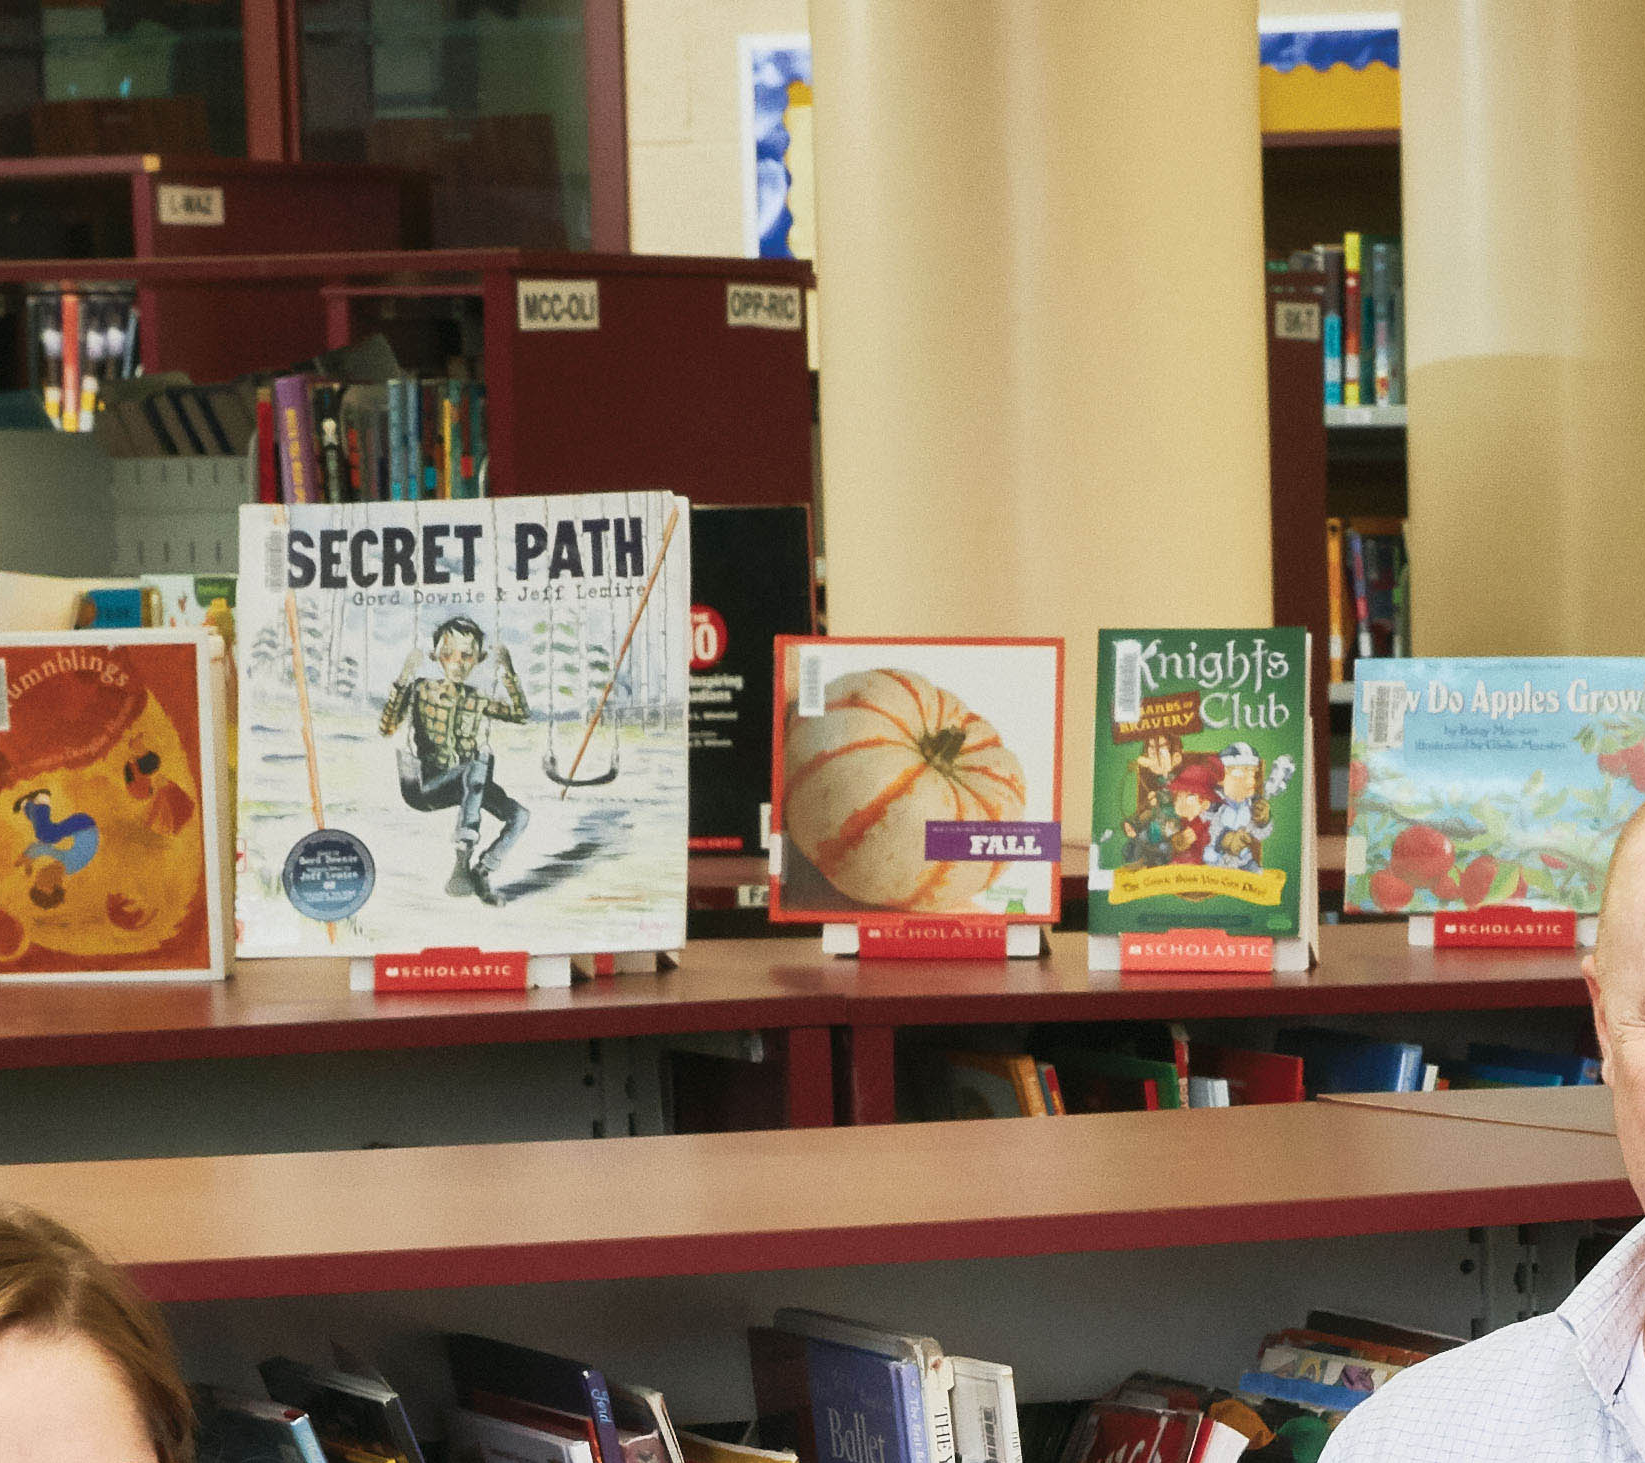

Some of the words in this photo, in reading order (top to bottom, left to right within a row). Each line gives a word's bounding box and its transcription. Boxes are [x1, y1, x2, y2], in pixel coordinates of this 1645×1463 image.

[524, 292, 596, 324] MCC-OLI
[730, 290, 799, 323] OPP-RIC
[287, 524, 483, 589] SECRET
[513, 516, 646, 580] PATH
[353, 588, 401, 609] Gord
[412, 587, 484, 606] Downie
[519, 585, 566, 604] Jeff
[1199, 692, 1290, 731] Club
[1428, 680, 1464, 714] Do
[1471, 680, 1560, 720] Apples
[970, 833, 1042, 857] FALL
[883, 925, 1002, 941] SCHOLASTIC
[1459, 923, 1563, 936] SCHOLASTIC
[1144, 942, 1270, 959] SCHOLASTIC
[401, 964, 513, 979] SCHOLASTIC
[933, 1405, 950, 1452] THE
